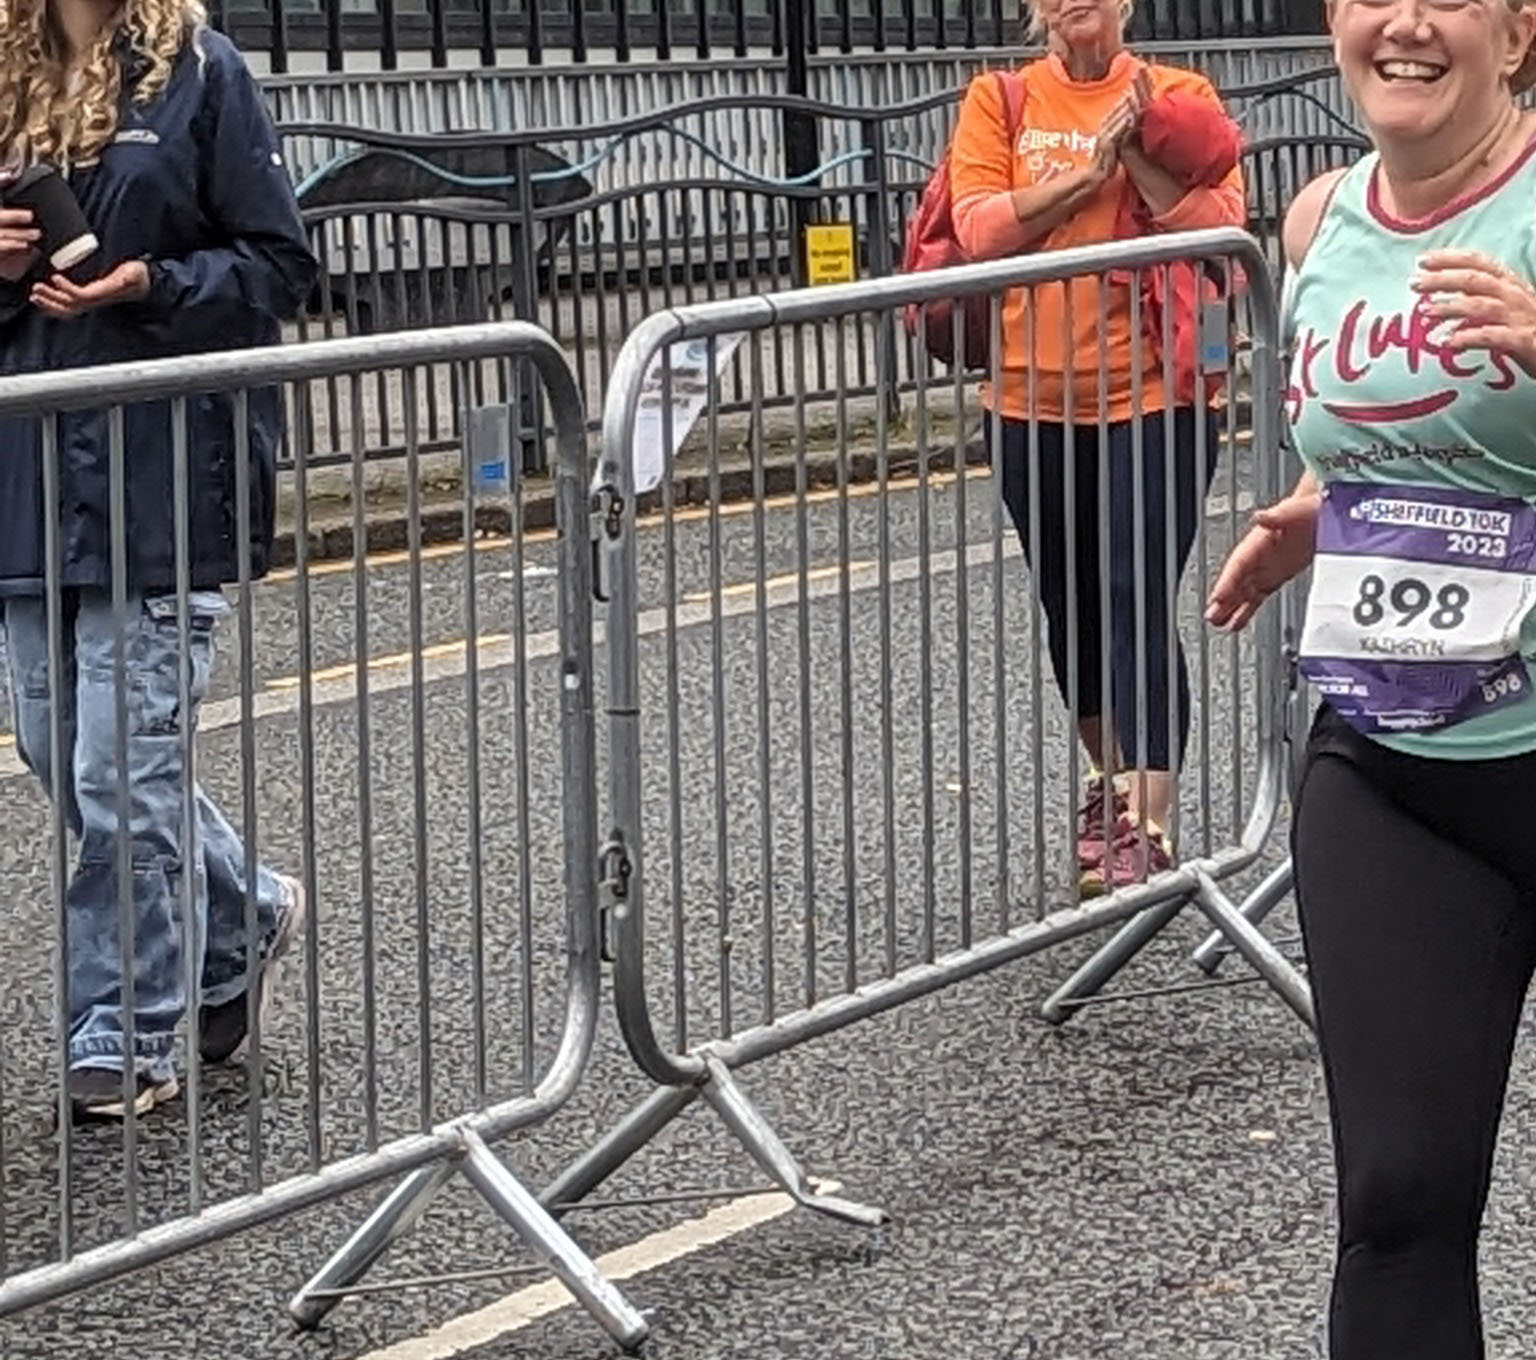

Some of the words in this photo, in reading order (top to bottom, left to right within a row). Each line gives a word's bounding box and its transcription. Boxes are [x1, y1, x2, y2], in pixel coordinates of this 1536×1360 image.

[1374, 503, 1466, 529] SHEFFIELD
[1470, 511, 1508, 532] 10K
[1447, 534, 1507, 558] 2023
[1353, 574, 1470, 630] 898
